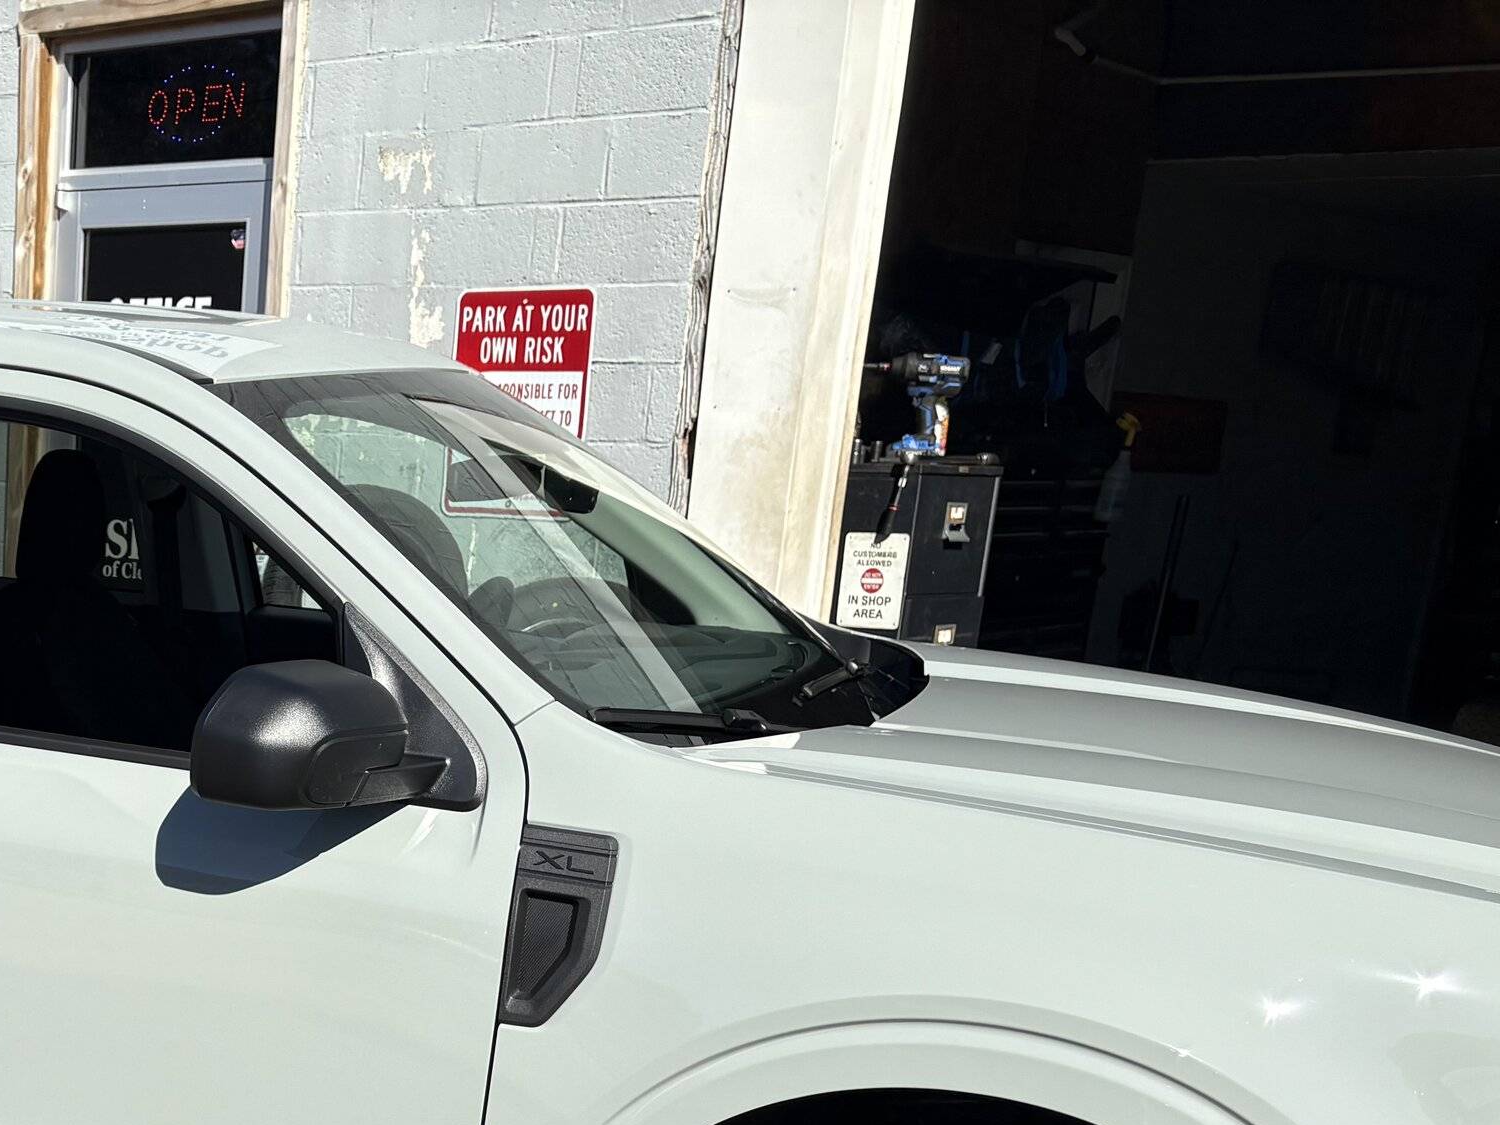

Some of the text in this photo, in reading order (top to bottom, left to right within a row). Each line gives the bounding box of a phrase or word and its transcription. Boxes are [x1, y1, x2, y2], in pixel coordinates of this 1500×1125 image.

[148, 82, 245, 125] OPEN
[461, 304, 589, 333] PARK AT YOUR
[480, 336, 565, 364] OWN RISK
[558, 384, 579, 399] FOR
[560, 410, 572, 426] TO
[853, 550, 898, 559] CUSTOMERS
[102, 560, 120, 578] of
[857, 559, 892, 567] ALLOWED
[848, 595, 891, 606] IN SHOP
[853, 609, 883, 619] AREA
[533, 850, 595, 875] XL
